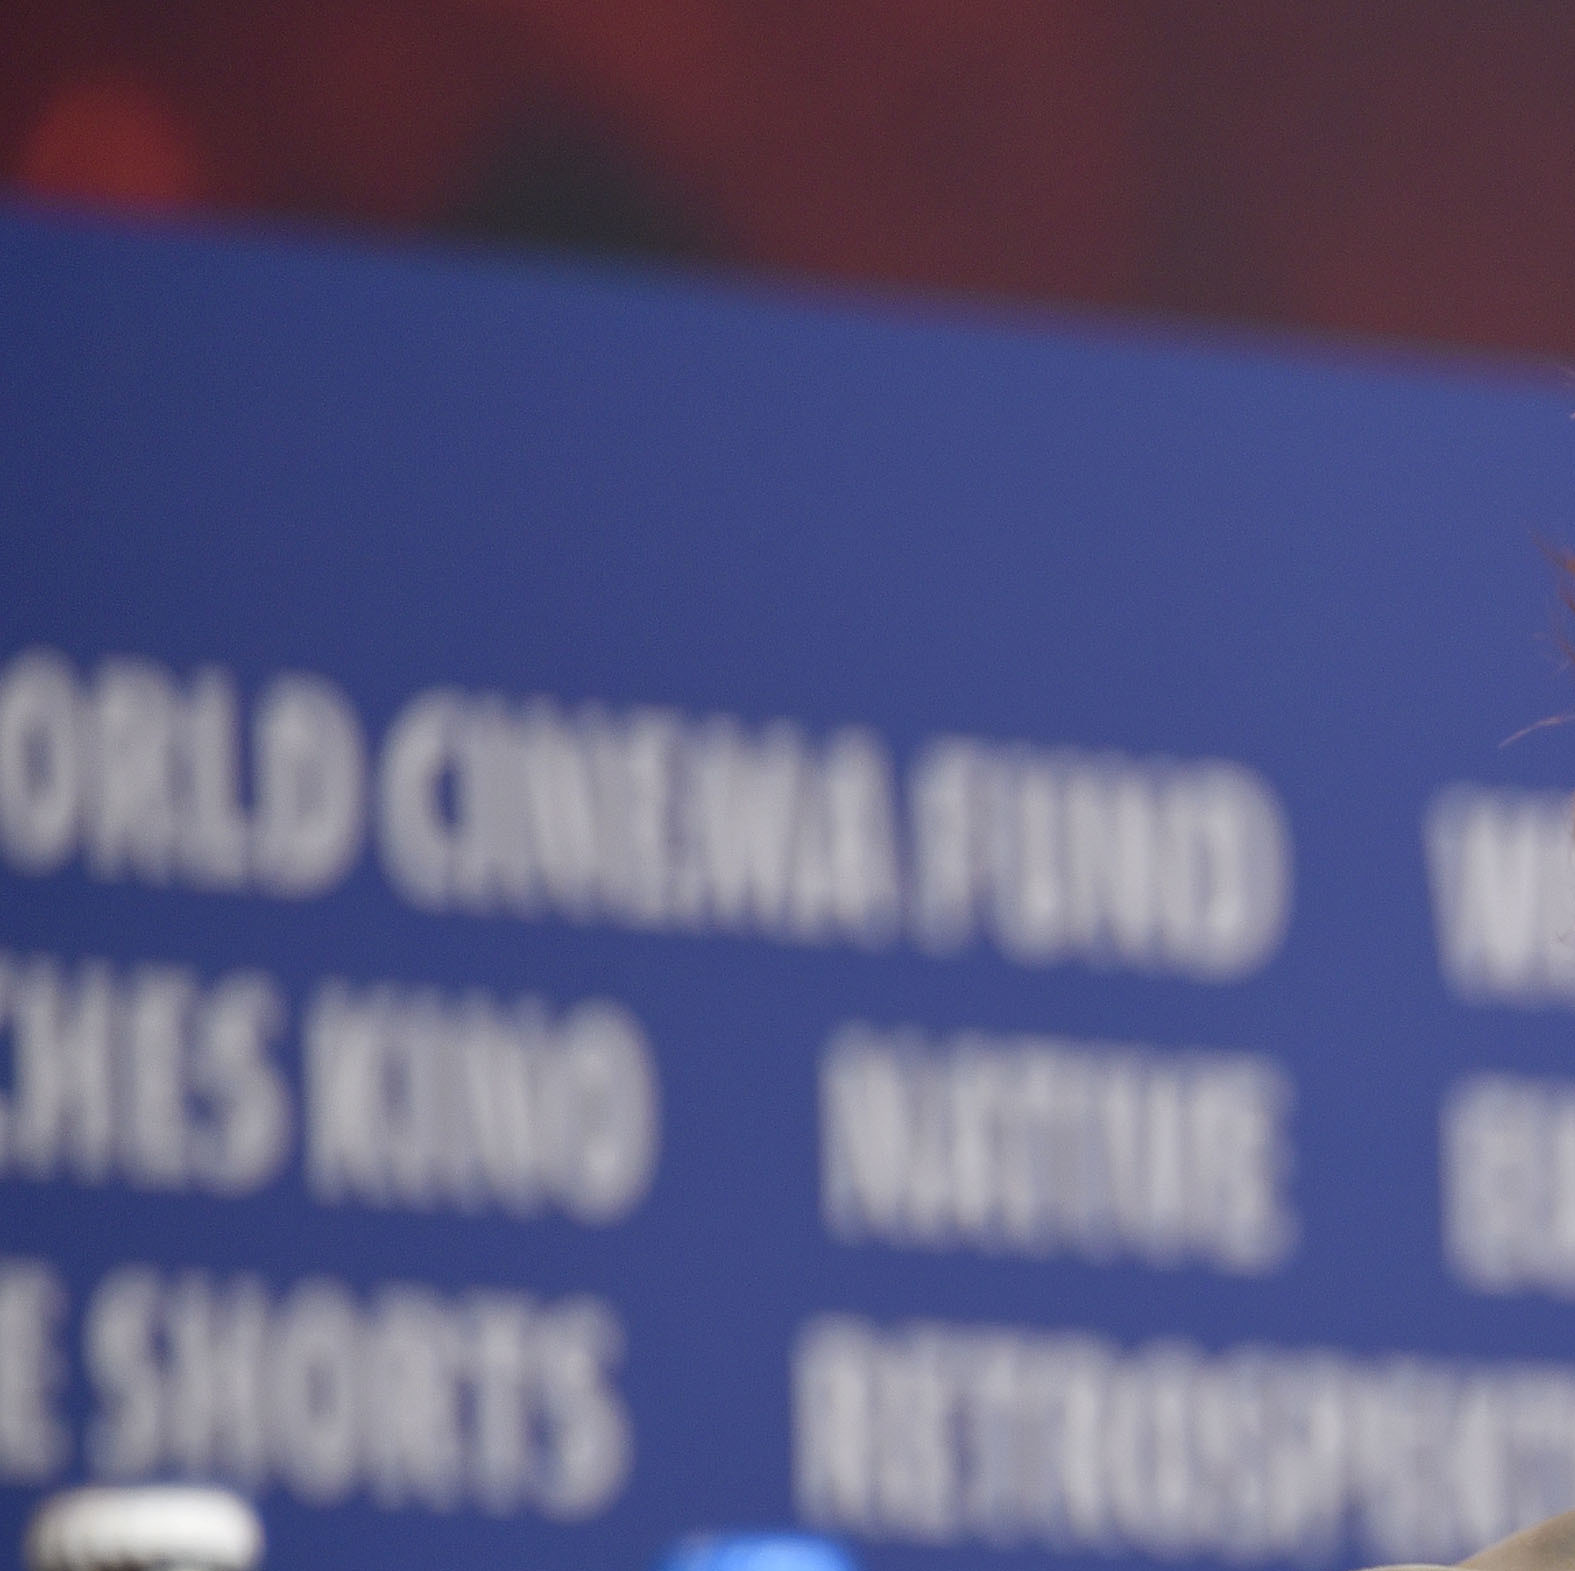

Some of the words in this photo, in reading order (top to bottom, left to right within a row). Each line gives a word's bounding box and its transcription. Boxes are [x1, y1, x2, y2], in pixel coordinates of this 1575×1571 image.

[382, 690, 896, 943] CINEMA
[912, 736, 1291, 979] FUND
[305, 981, 658, 1223] KINO
[823, 1027, 1295, 1274] NATIVE
[83, 1265, 629, 1521] SHORTS
